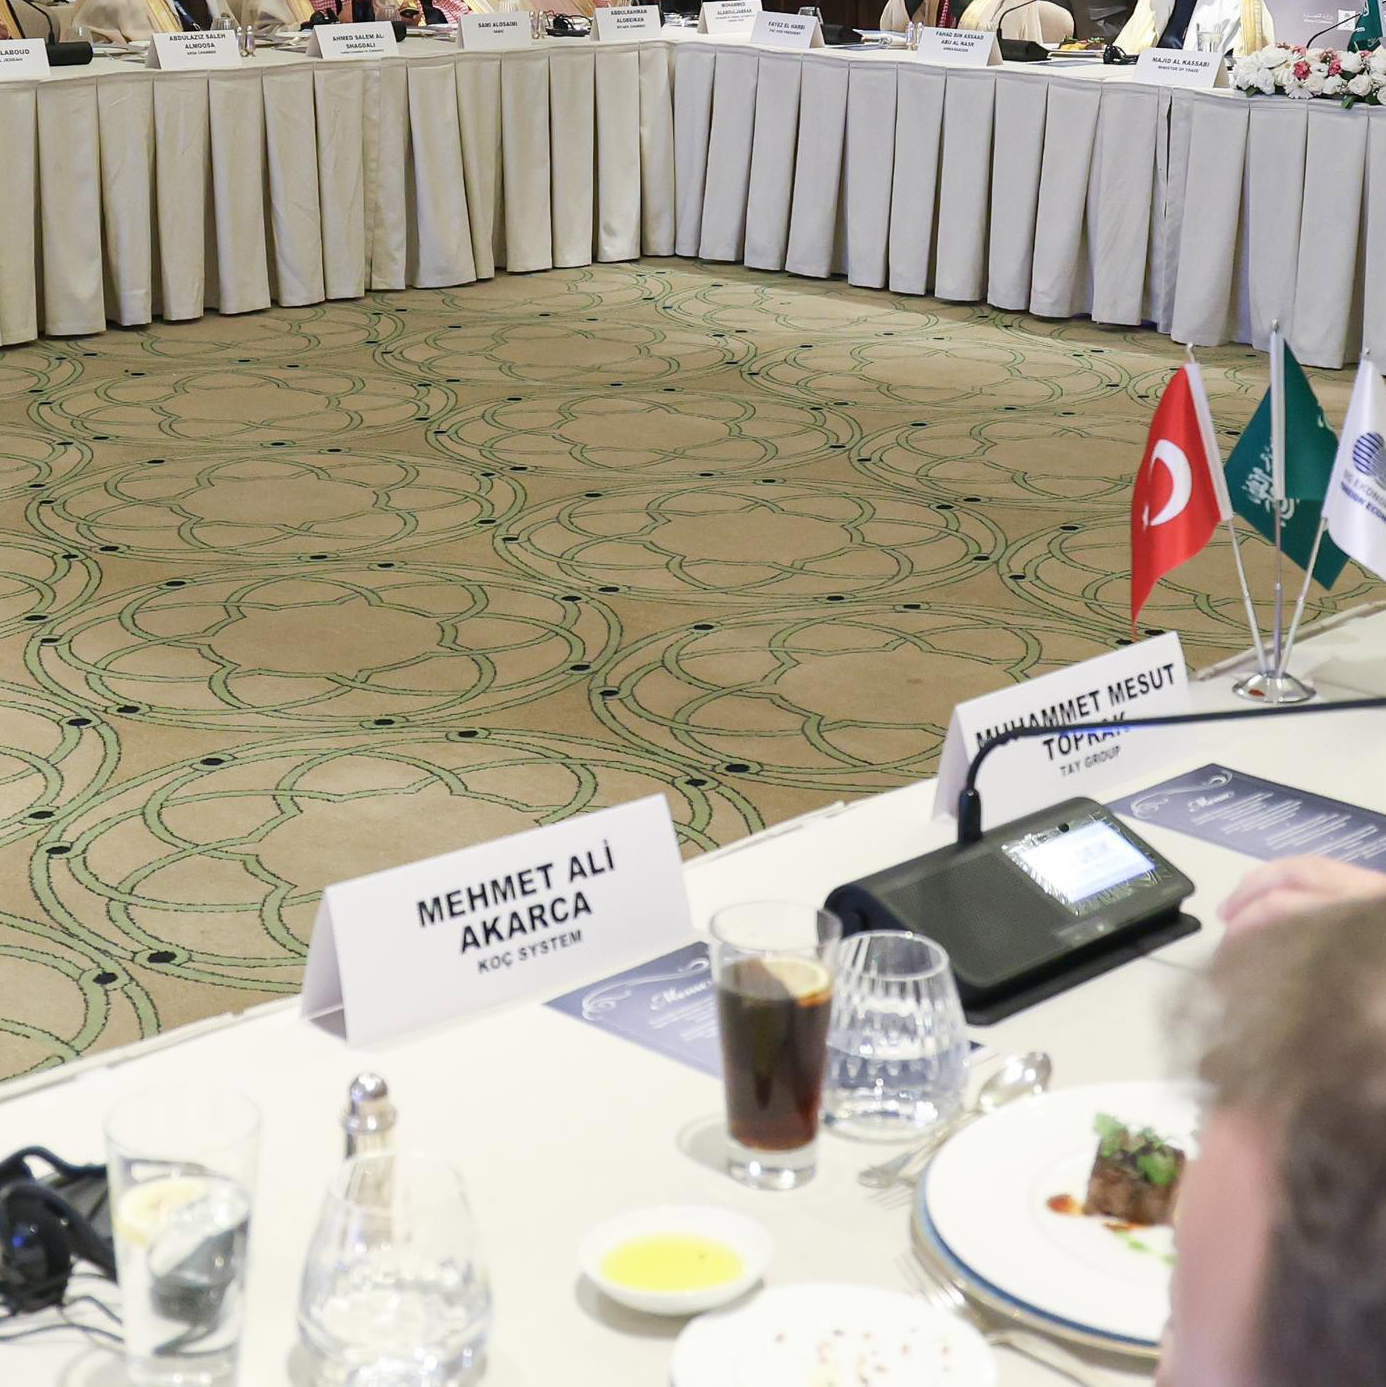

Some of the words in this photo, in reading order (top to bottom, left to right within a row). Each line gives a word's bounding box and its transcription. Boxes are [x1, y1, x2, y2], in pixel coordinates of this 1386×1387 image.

[1107, 663, 1175, 707] MESUT
[1059, 760, 1081, 777] TAY
[1084, 745, 1121, 768] GROUP
[417, 862, 555, 928] MEHMET
[567, 839, 615, 883] ALİ
[460, 890, 593, 956] AKARCA
[477, 951, 513, 975] KOÇ
[517, 929, 583, 961] SYSTEM
